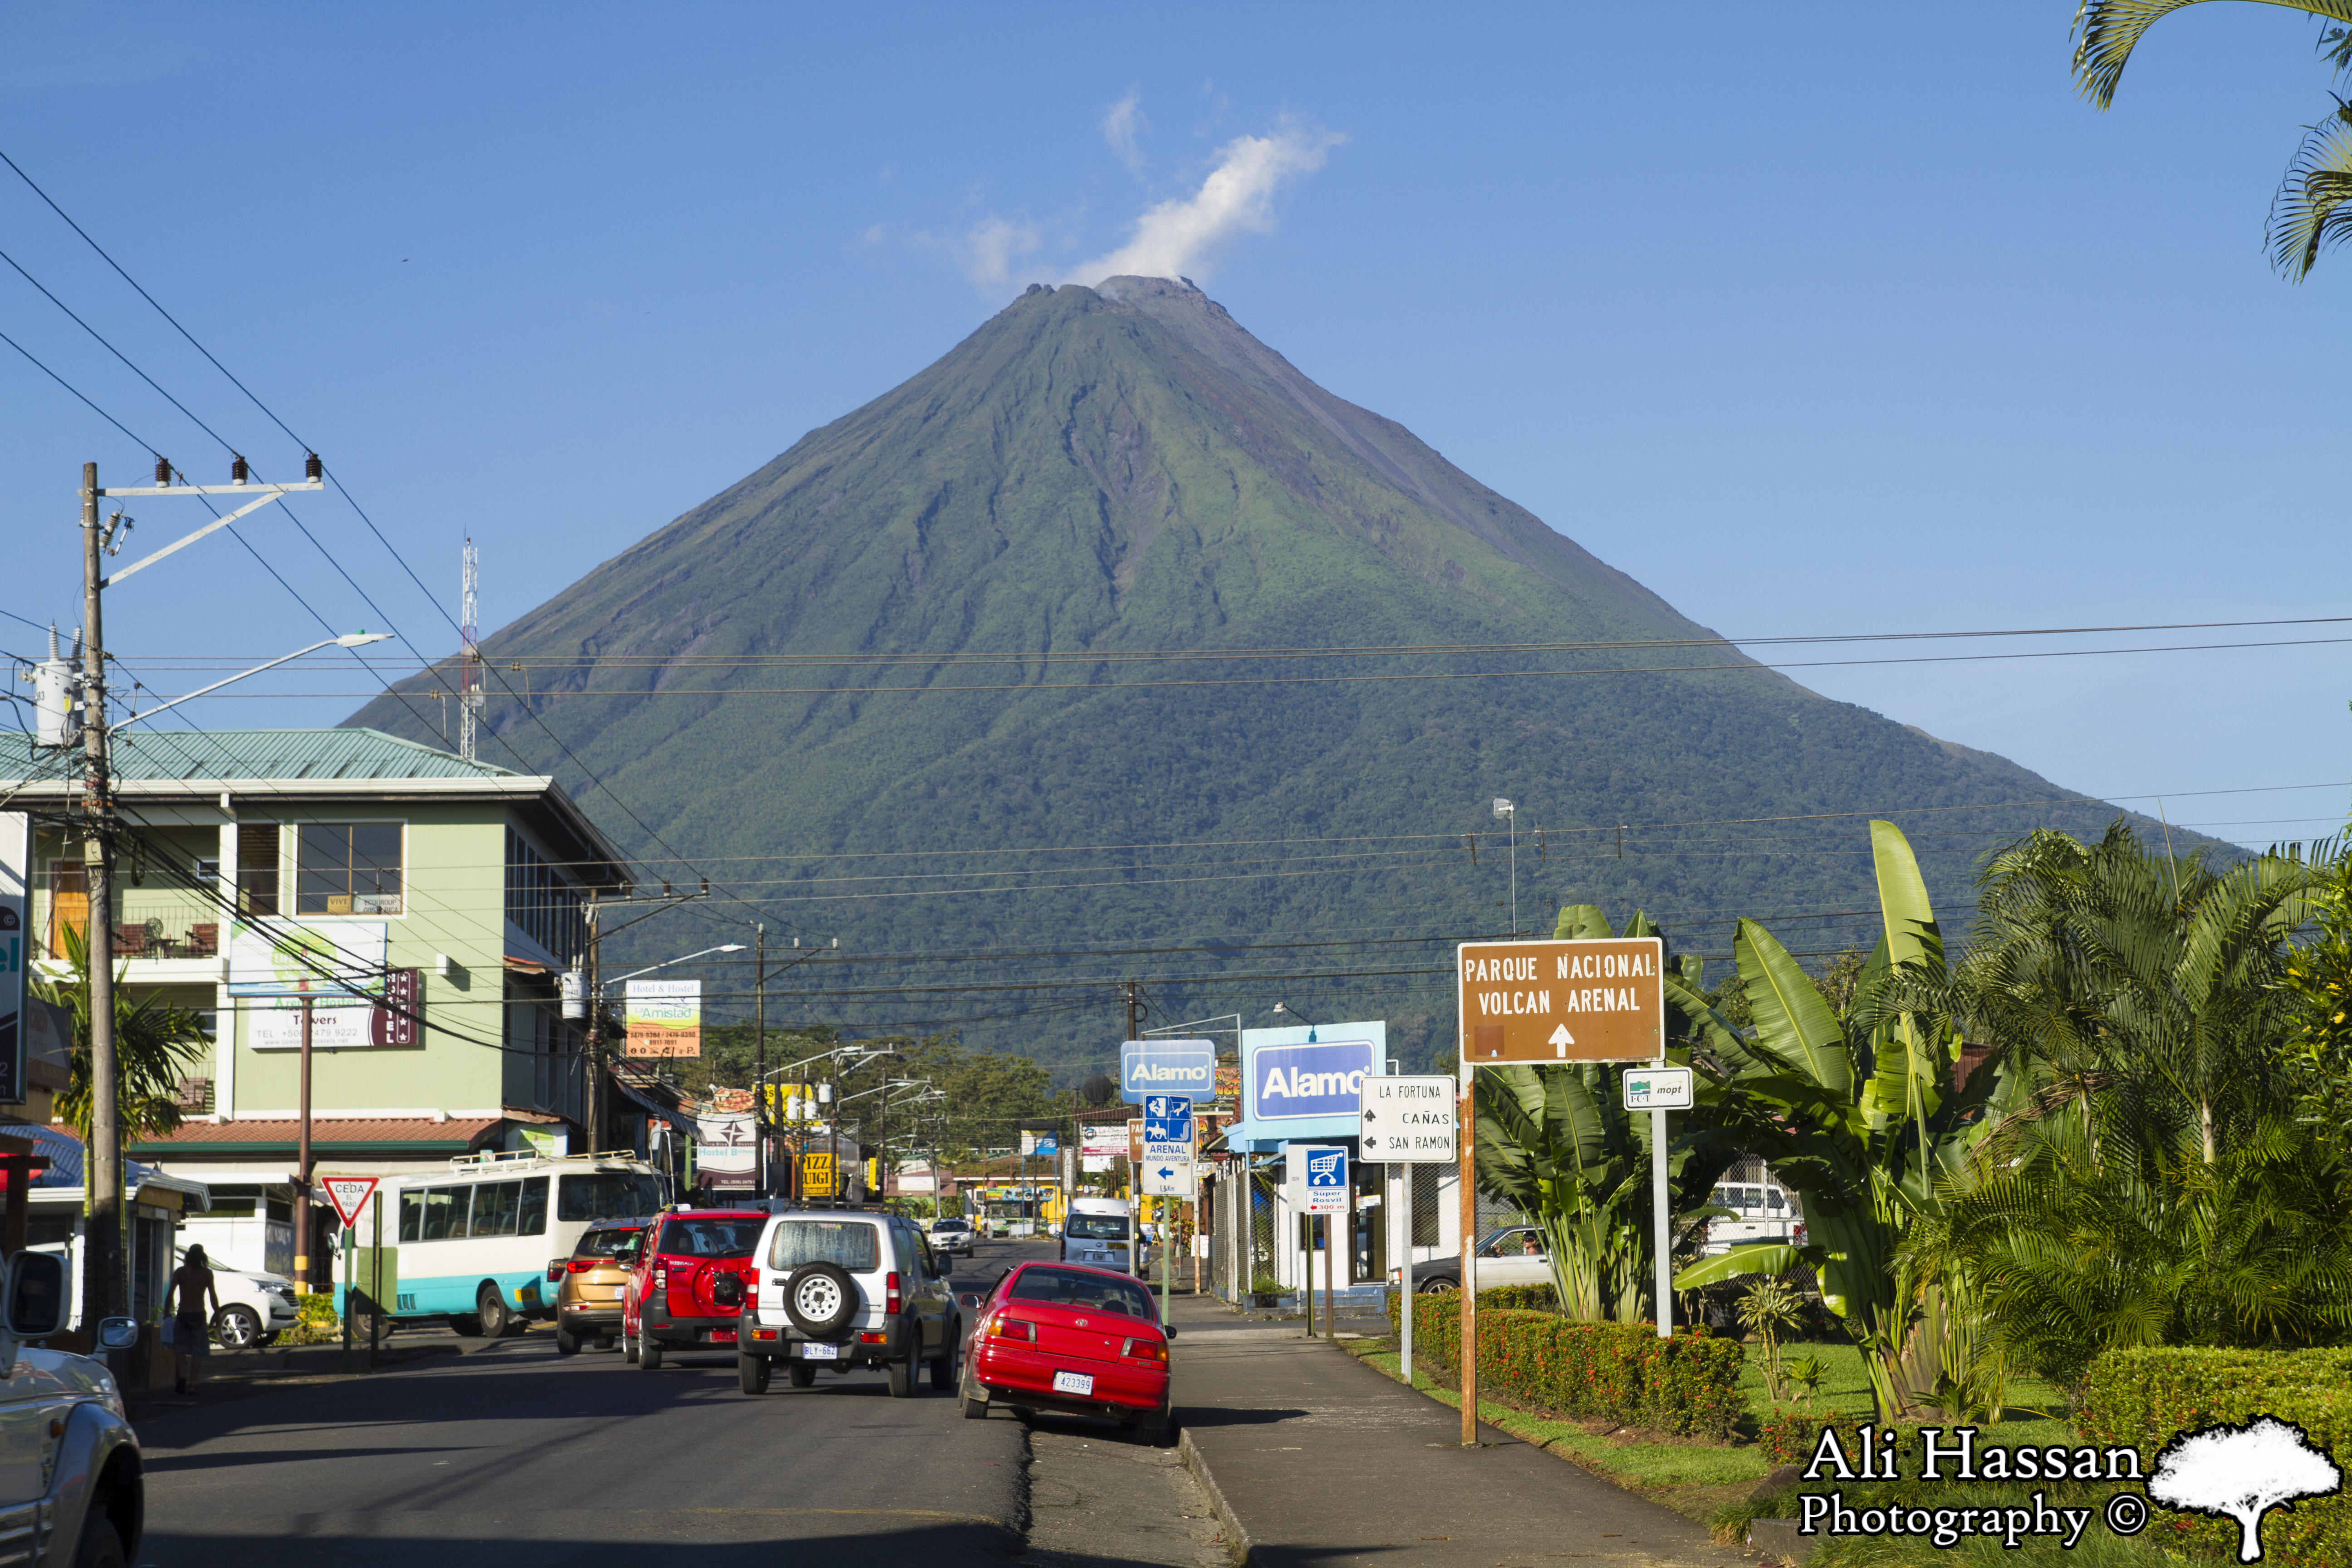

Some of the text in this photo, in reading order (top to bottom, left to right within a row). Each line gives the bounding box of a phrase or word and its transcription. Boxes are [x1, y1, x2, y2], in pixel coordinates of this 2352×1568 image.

[1465, 954, 1655, 981] PARQUE NACIONAL
[633, 985, 655, 993] Hotel
[668, 984, 694, 992] Hostel
[1479, 988, 1640, 1015] VOLCAN ARENAL
[642, 1008, 691, 1018] Amistad
[1131, 1064, 1206, 1081] Alamo
[1380, 1086, 1441, 1098] LA FORTUNA
[1657, 1085, 1682, 1095] mopt
[1402, 1111, 1449, 1124] CAÑAS
[1150, 1145, 1186, 1153] ARENAL
[1389, 1137, 1450, 1149] SAN RAMON
[336, 1184, 364, 1193] CEDA
[805, 1346, 835, 1355] BLY-662
[1061, 1377, 1090, 1390] 423399
